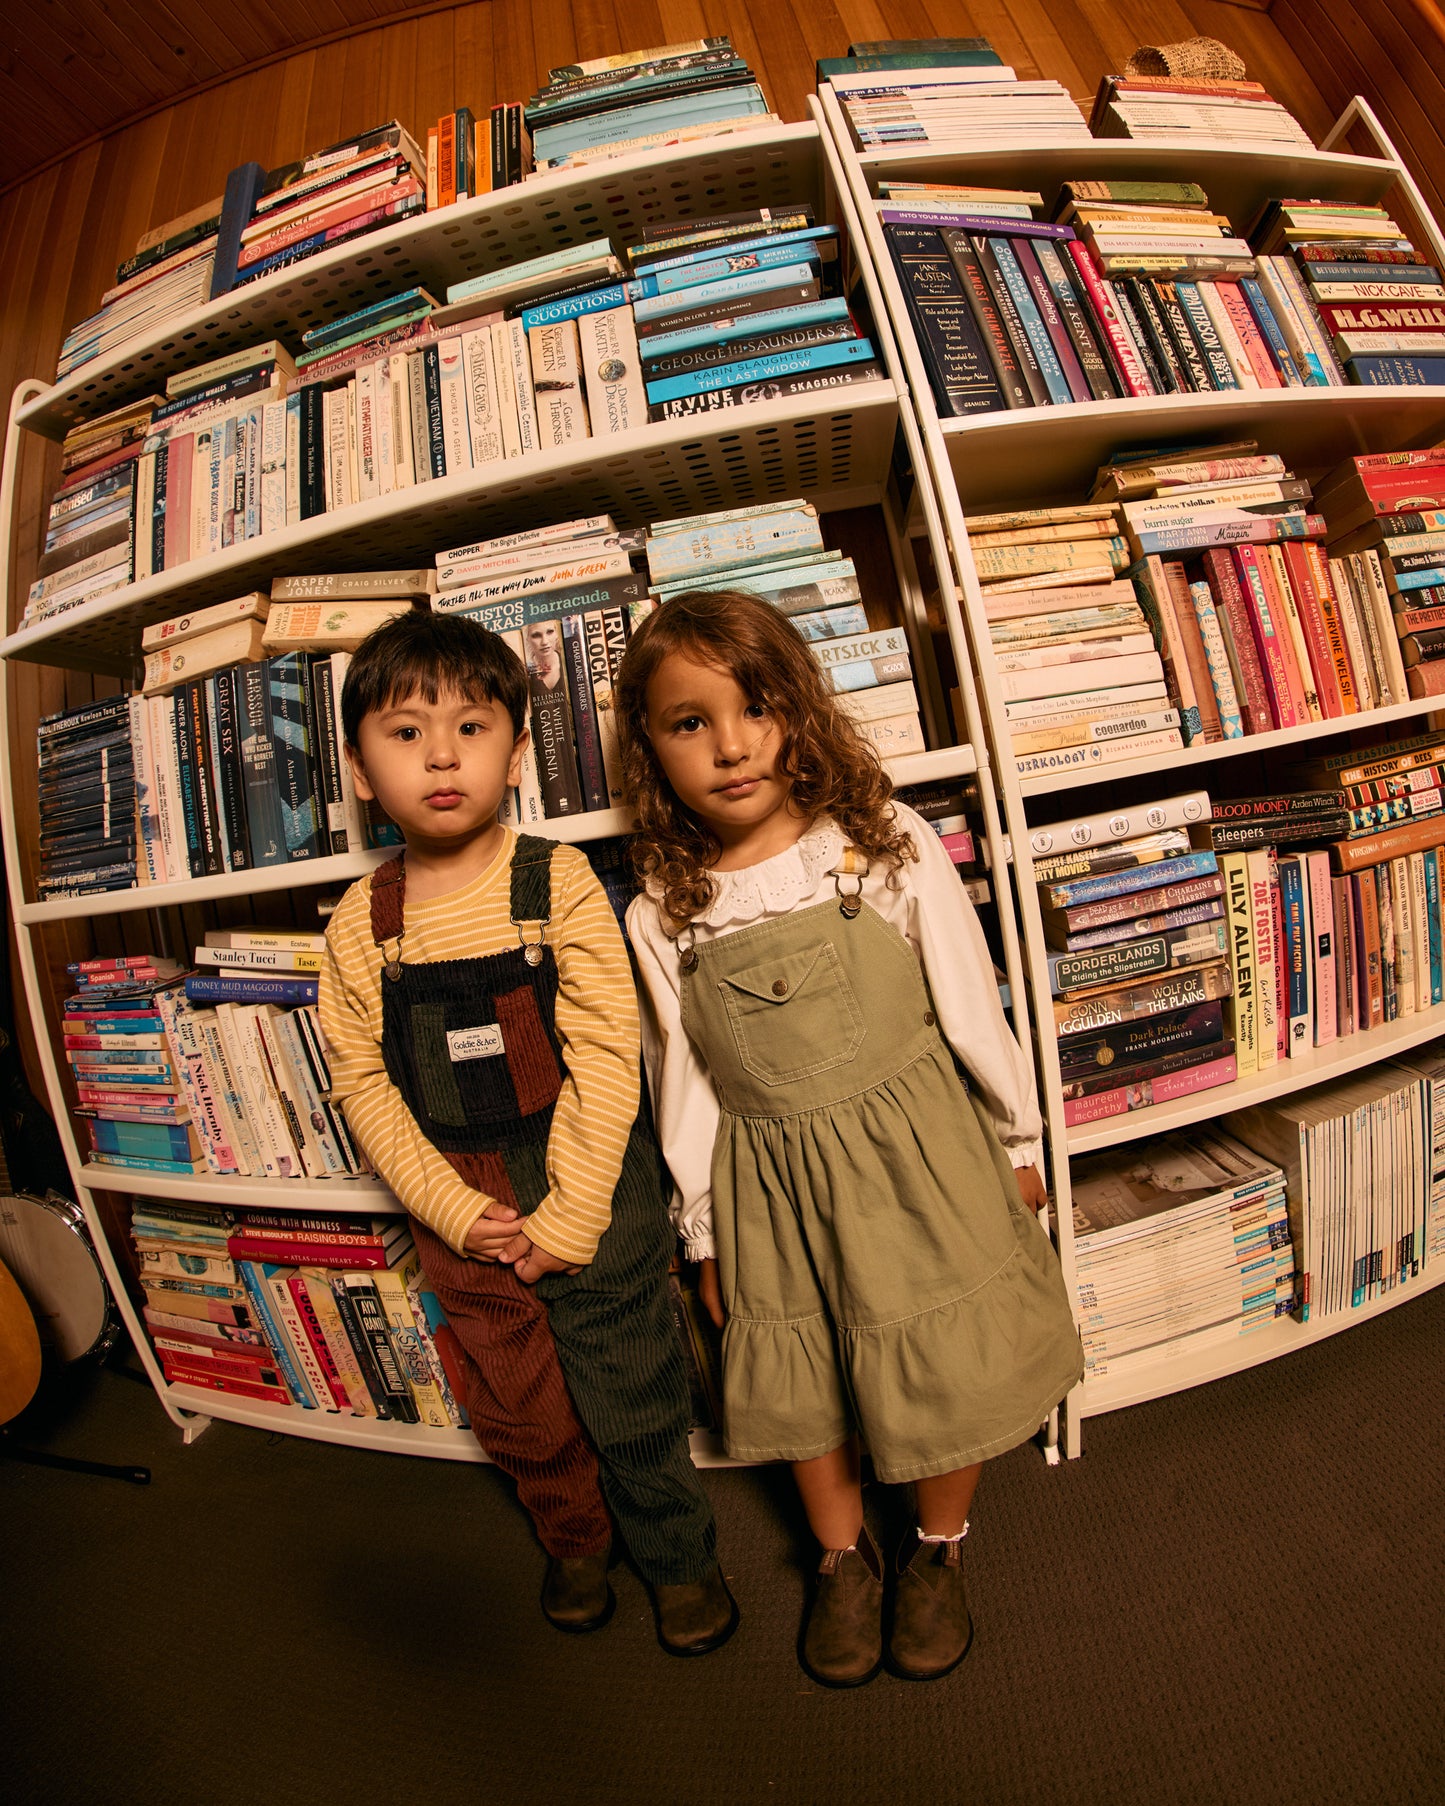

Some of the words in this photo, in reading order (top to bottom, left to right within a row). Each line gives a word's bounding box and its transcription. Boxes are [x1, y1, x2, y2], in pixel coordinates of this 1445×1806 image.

[568, 76, 596, 87] ROOM
[596, 68, 635, 80] OUTSIDE
[557, 92, 587, 103] URBAN
[590, 83, 625, 95] JUNGLE
[581, 137, 638, 158] waterside
[643, 130, 680, 144] living
[1020, 222, 1052, 230] REIMAGINED
[914, 272, 951, 281] AUSTEN
[996, 246, 1022, 303] OURSELVES
[1033, 276, 1058, 324] sunbathing
[1043, 251, 1075, 308] HANNAH
[1069, 312, 1091, 348] KENT
[1353, 285, 1388, 296] NICK
[1388, 286, 1425, 297] CAVE
[528, 290, 622, 324] QUOTATIONS
[727, 302, 751, 312] LAWRENCE
[737, 310, 785, 322] MARGARET
[787, 302, 827, 313] ATWOOD
[965, 264, 988, 306] ALMOST
[982, 307, 1016, 371] CHIMPANZEE
[660, 318, 683, 328] WOMEN
[994, 270, 1002, 281] THE
[999, 283, 1017, 317] TATTOOIST
[1018, 330, 1037, 370] AUSCHWITZ
[1184, 295, 1221, 348] PATTERSON
[397, 335, 428, 349] JAMIE
[430, 324, 461, 338] DURIE
[594, 317, 609, 359] MARTIN
[646, 333, 673, 343] MORAL
[675, 324, 711, 337] DISORDER
[541, 329, 556, 372] MARTIN
[659, 348, 725, 371] GEORGE
[748, 326, 835, 352] SAUNDERS
[295, 376, 310, 385] THE
[313, 359, 356, 380] OUTDOOR
[362, 347, 391, 361] ROOM
[693, 366, 732, 381] KARIN
[737, 350, 812, 371] SLAUGHTER
[698, 378, 724, 389] THE
[728, 370, 758, 384] LAST
[763, 359, 811, 375] WIDOW
[790, 374, 852, 393] SKAGBOYS
[167, 401, 185, 412] SECRET
[187, 396, 197, 404] LIFE
[206, 384, 226, 397] WHALES
[663, 389, 734, 415] IRVINE
[430, 396, 442, 442] VIETNAM
[550, 398, 564, 445] THRONES
[1144, 518, 1169, 528] burnt
[1171, 517, 1194, 526] sugar
[1157, 530, 1184, 539] MARY
[1187, 527, 1207, 535] ANN
[448, 547, 480, 559] CHOPPER
[1166, 537, 1209, 548] AUTUMN
[457, 565, 481, 574] DAVID
[483, 558, 520, 569] MITCHELL
[550, 571, 574, 583] JOHN
[577, 561, 608, 575] GREEN
[1308, 546, 1328, 599] Trainspotting
[1369, 556, 1382, 589] JAWS
[286, 577, 333, 588] JASPER
[342, 580, 370, 588] CRAIG
[374, 578, 406, 587] SILVEY
[288, 587, 330, 596] JONES
[503, 581, 521, 594] WAY
[523, 575, 546, 588] DOWN
[529, 590, 610, 616] barracuda
[1252, 570, 1274, 637] WOLFE
[1311, 602, 1322, 634] EASTON
[1319, 634, 1328, 660] ELLIS
[1406, 614, 1417, 625] THE
[587, 620, 608, 684] BLOCK
[816, 641, 880, 665] ARTSICK
[1326, 617, 1342, 653] IRVINE
[1336, 658, 1351, 696] WELSH
[218, 677, 230, 723] GREAT
[533, 692, 564, 701] BELINDA
[178, 699, 186, 727] NEVER
[553, 707, 564, 742] WHITE
[1095, 719, 1147, 739] coonardoo
[180, 730, 188, 760] ALONE
[222, 729, 233, 755] SEX
[540, 710, 558, 781] GARDENIA
[1345, 770, 1362, 781] THE
[1363, 761, 1398, 776] HISTORY
[1401, 758, 1412, 767] OF
[183, 765, 193, 810] ELIZABETH
[188, 812, 197, 849] HAYNES
[199, 767, 210, 830] CLEMENTINE
[1213, 804, 1251, 818] BLOOD
[1253, 800, 1290, 816] MONEY
[1291, 799, 1312, 809] Arden
[1314, 796, 1335, 807] Winch
[1217, 828, 1265, 842] sleepers
[1056, 862, 1091, 877] MOVIES
[1168, 881, 1212, 898] CHARLAINE
[1178, 892, 1207, 903] HARRIS
[1230, 869, 1246, 916] LILY
[1256, 911, 1271, 965] FOSTER
[213, 951, 246, 965] Stanley
[250, 953, 276, 964] Tucci
[297, 958, 317, 966] Taste
[1062, 944, 1160, 974] BORDERLANDS
[1235, 926, 1251, 998] ALLEN
[1072, 971, 1097, 982] Riding
[1114, 958, 1155, 973] Slipstream
[243, 984, 283, 992] MAGGOTS
[1152, 983, 1182, 998] WOLF
[1184, 979, 1197, 990] OF
[1070, 1001, 1107, 1018] CONN
[1147, 1000, 1168, 1012] THE
[1170, 989, 1206, 1008] PLAINS
[1060, 1010, 1122, 1034] IGGULDEN
[1130, 1030, 1154, 1043] Dark
[1158, 1022, 1187, 1035] Palace
[454, 1040, 475, 1049] Goldie
[476, 1039, 484, 1047] &
[1125, 1043, 1148, 1052] FRANK
[1151, 1031, 1193, 1046] MOORHOUSE
[193, 1063, 207, 1093] Nick
[203, 1097, 222, 1143] Hornby
[1075, 1093, 1119, 1109] maureen
[247, 1214, 278, 1225] COOKING
[280, 1219, 299, 1228] WITH
[302, 1220, 340, 1231] KINDNESS
[297, 1233, 336, 1243] RAISING
[339, 1235, 367, 1244] BOYS
[361, 1301, 376, 1314] AYN
[364, 1317, 384, 1331] RAND
